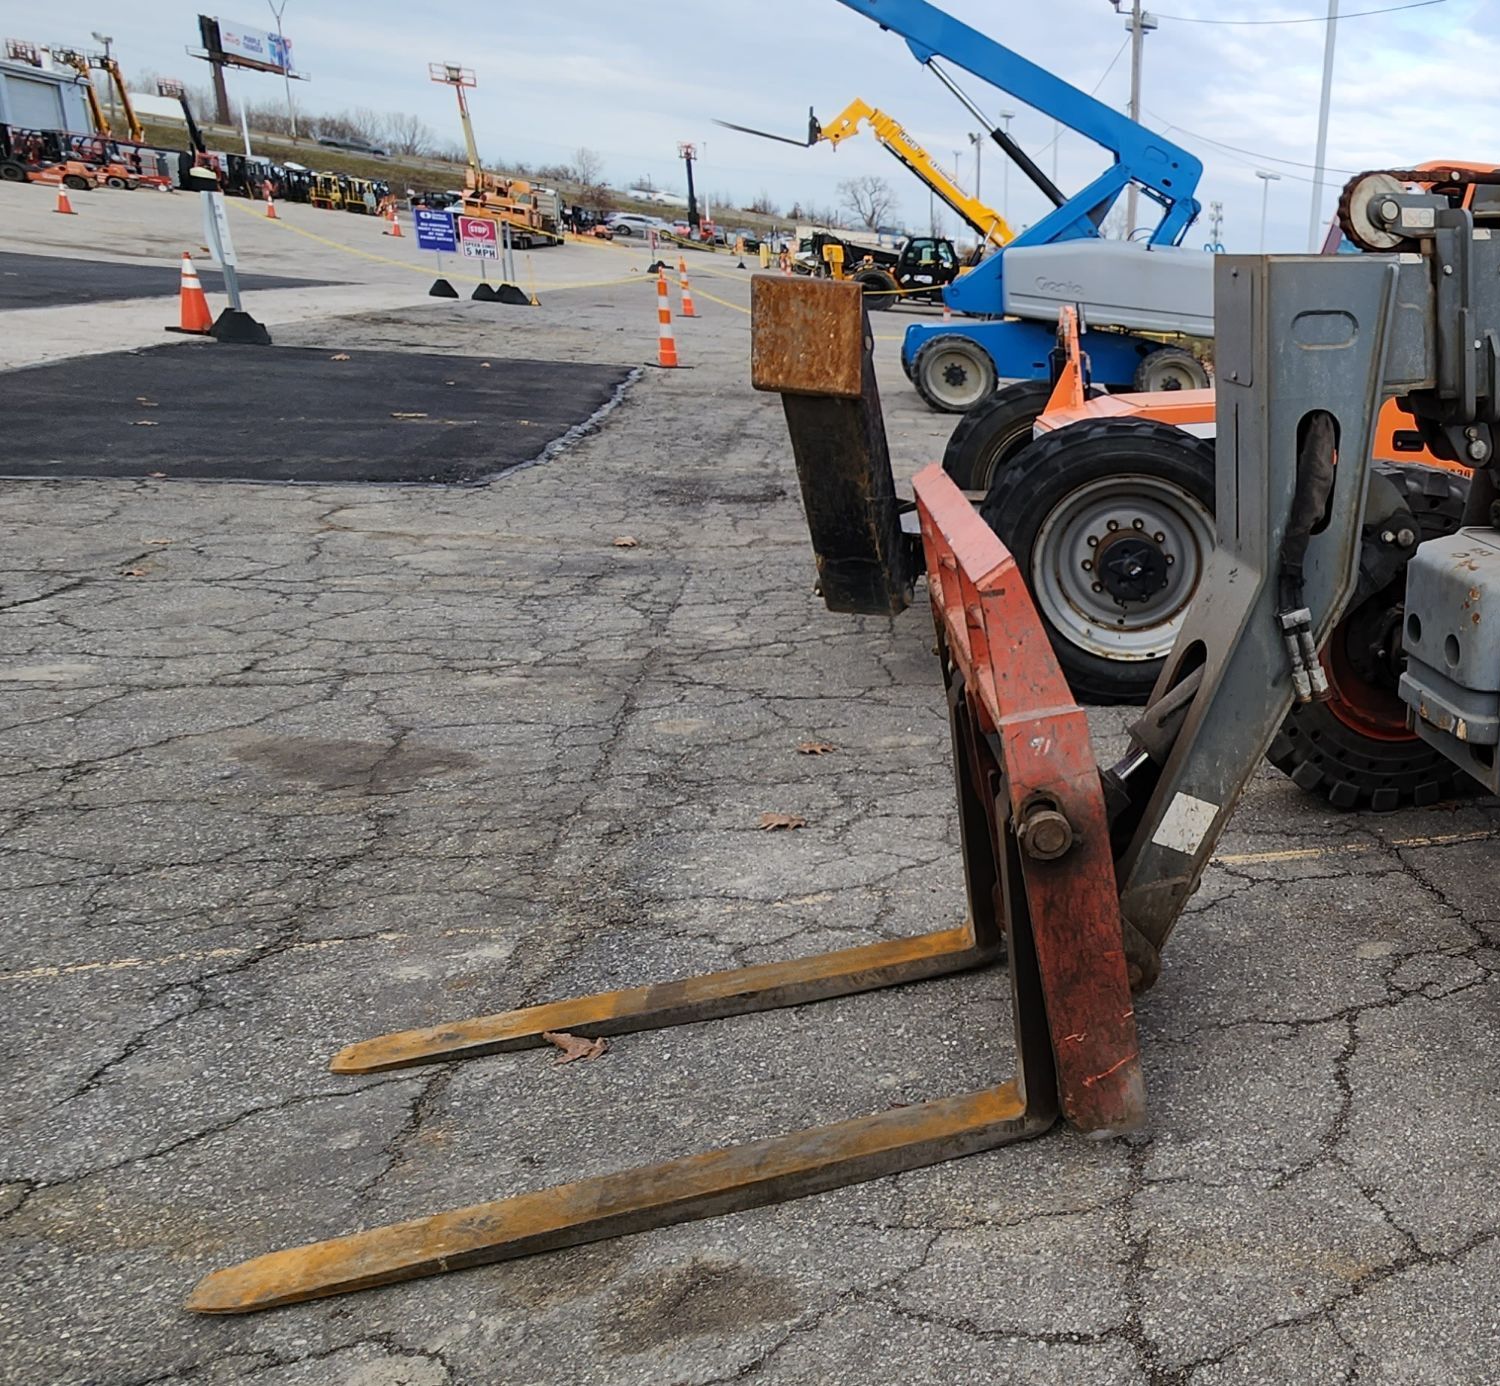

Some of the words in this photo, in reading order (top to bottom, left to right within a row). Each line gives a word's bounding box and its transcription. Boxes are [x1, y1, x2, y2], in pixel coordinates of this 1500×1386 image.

[469, 225, 487, 234] STOP
[466, 247, 472, 256] 5
[475, 249, 496, 258] MPH
